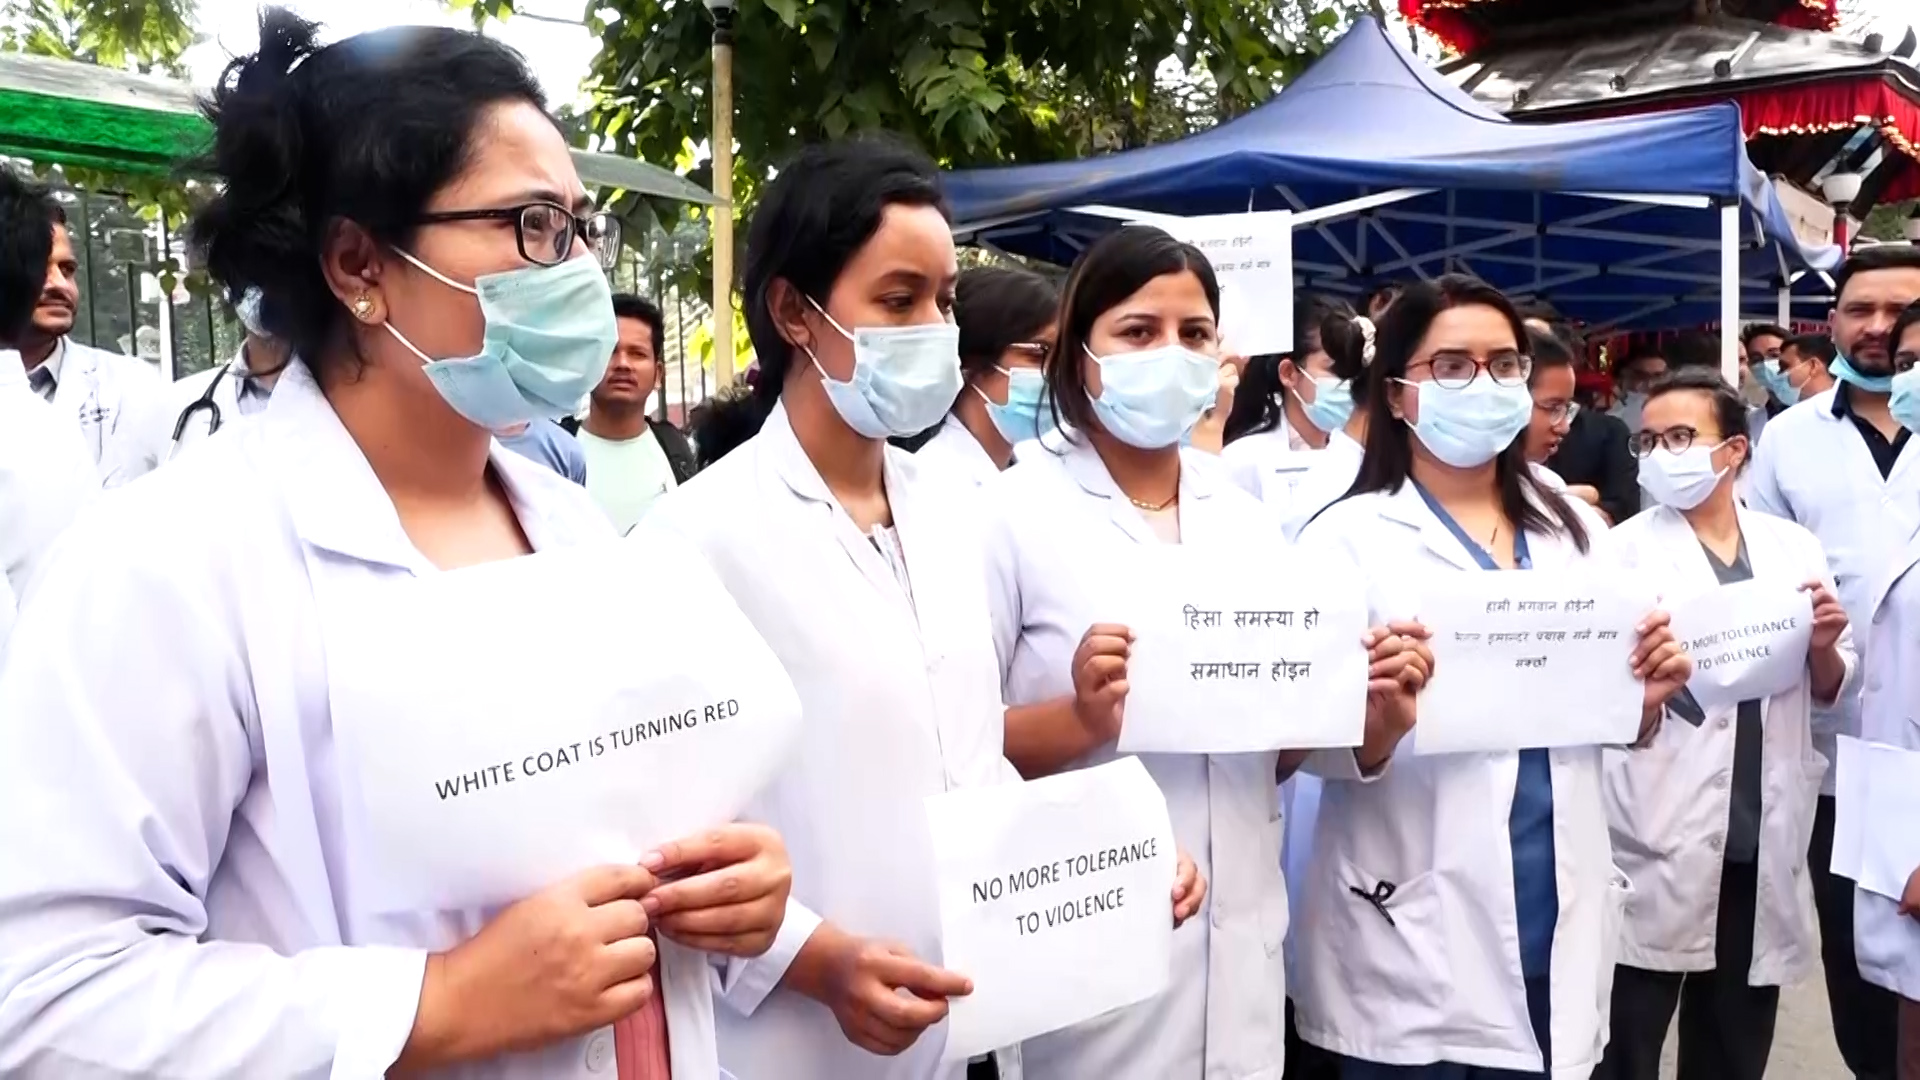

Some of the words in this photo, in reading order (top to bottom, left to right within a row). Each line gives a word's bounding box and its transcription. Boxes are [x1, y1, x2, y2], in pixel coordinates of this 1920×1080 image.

[1233, 611, 1294, 627] समस्या
[1304, 608, 1320, 630] हो
[1679, 640, 1690, 653] O
[1190, 662, 1261, 680] समाधान
[1272, 658, 1311, 682] होइन
[1697, 658, 1712, 671] TO
[434, 760, 516, 801] WHITE
[522, 742, 582, 777] COAT
[588, 735, 605, 758] IS
[608, 708, 698, 750] TURNING
[703, 698, 740, 724] RED
[972, 876, 1003, 904] NO
[1008, 861, 1061, 894] MORE
[1064, 836, 1158, 878] TOLERANCE
[1015, 911, 1040, 936] TO
[1044, 886, 1125, 928] VIOLENCE
